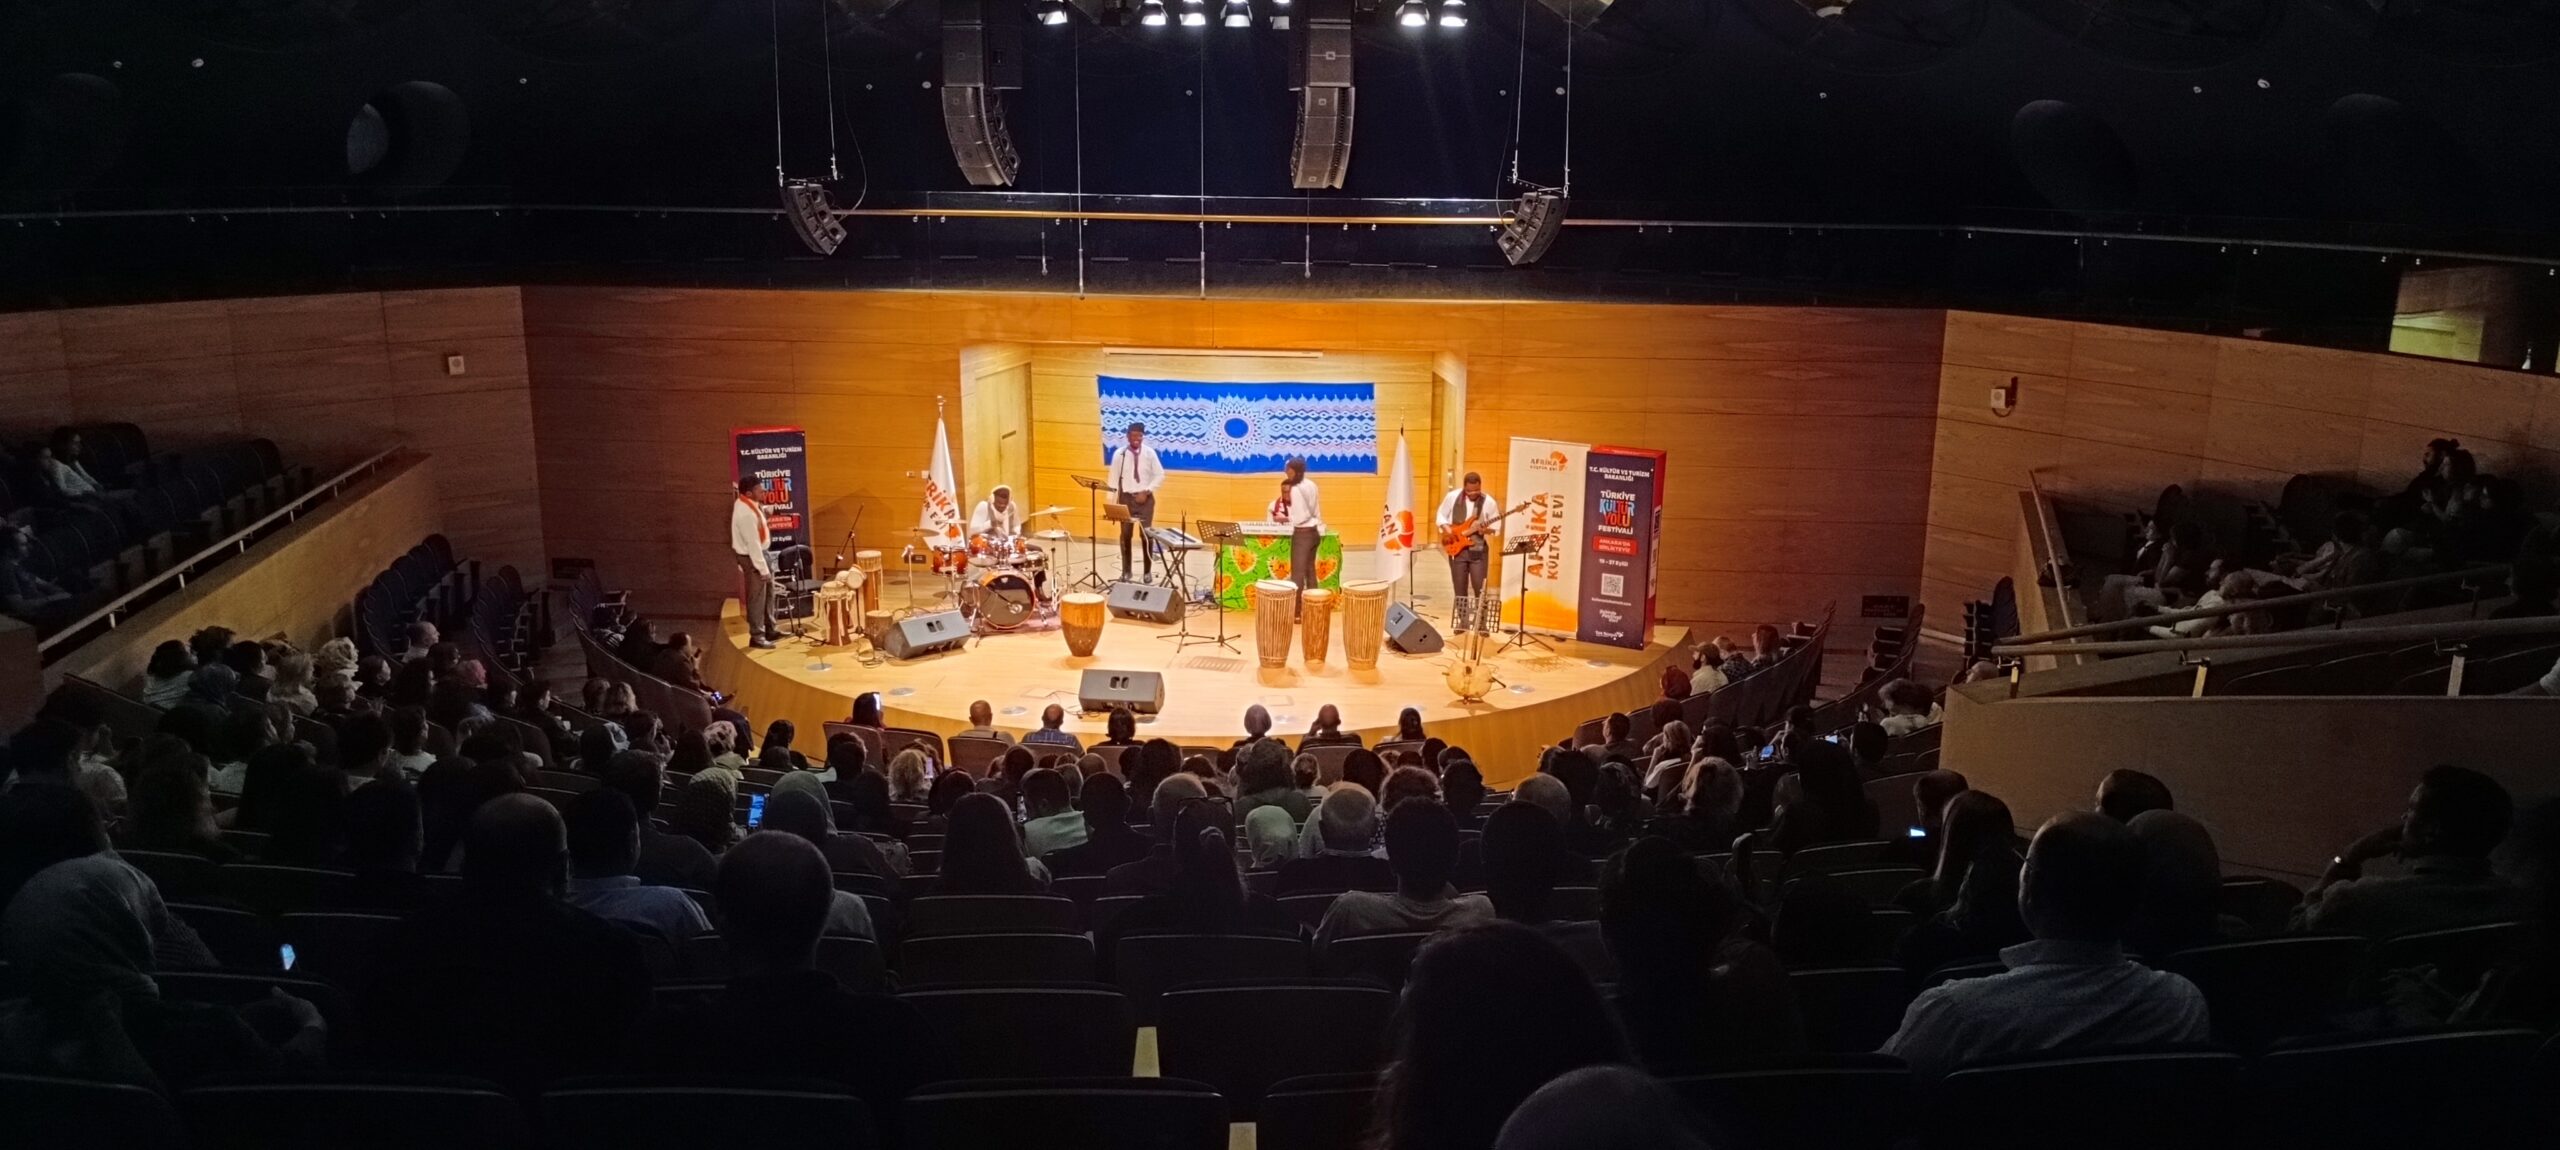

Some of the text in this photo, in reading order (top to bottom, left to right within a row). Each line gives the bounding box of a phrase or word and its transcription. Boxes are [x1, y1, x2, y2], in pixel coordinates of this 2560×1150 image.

[755, 468, 791, 479] TÜRKİYE
[1599, 466, 1620, 475] KÜLTÜR
[1600, 490, 1635, 501] TÜRKİYE
[1599, 498, 1635, 516] KÜLTÜR
[1603, 512, 1631, 527] YOLU
[1598, 524, 1634, 535] FESTİVALİ
[1547, 494, 1565, 580] KÜLTÜR EVİ
